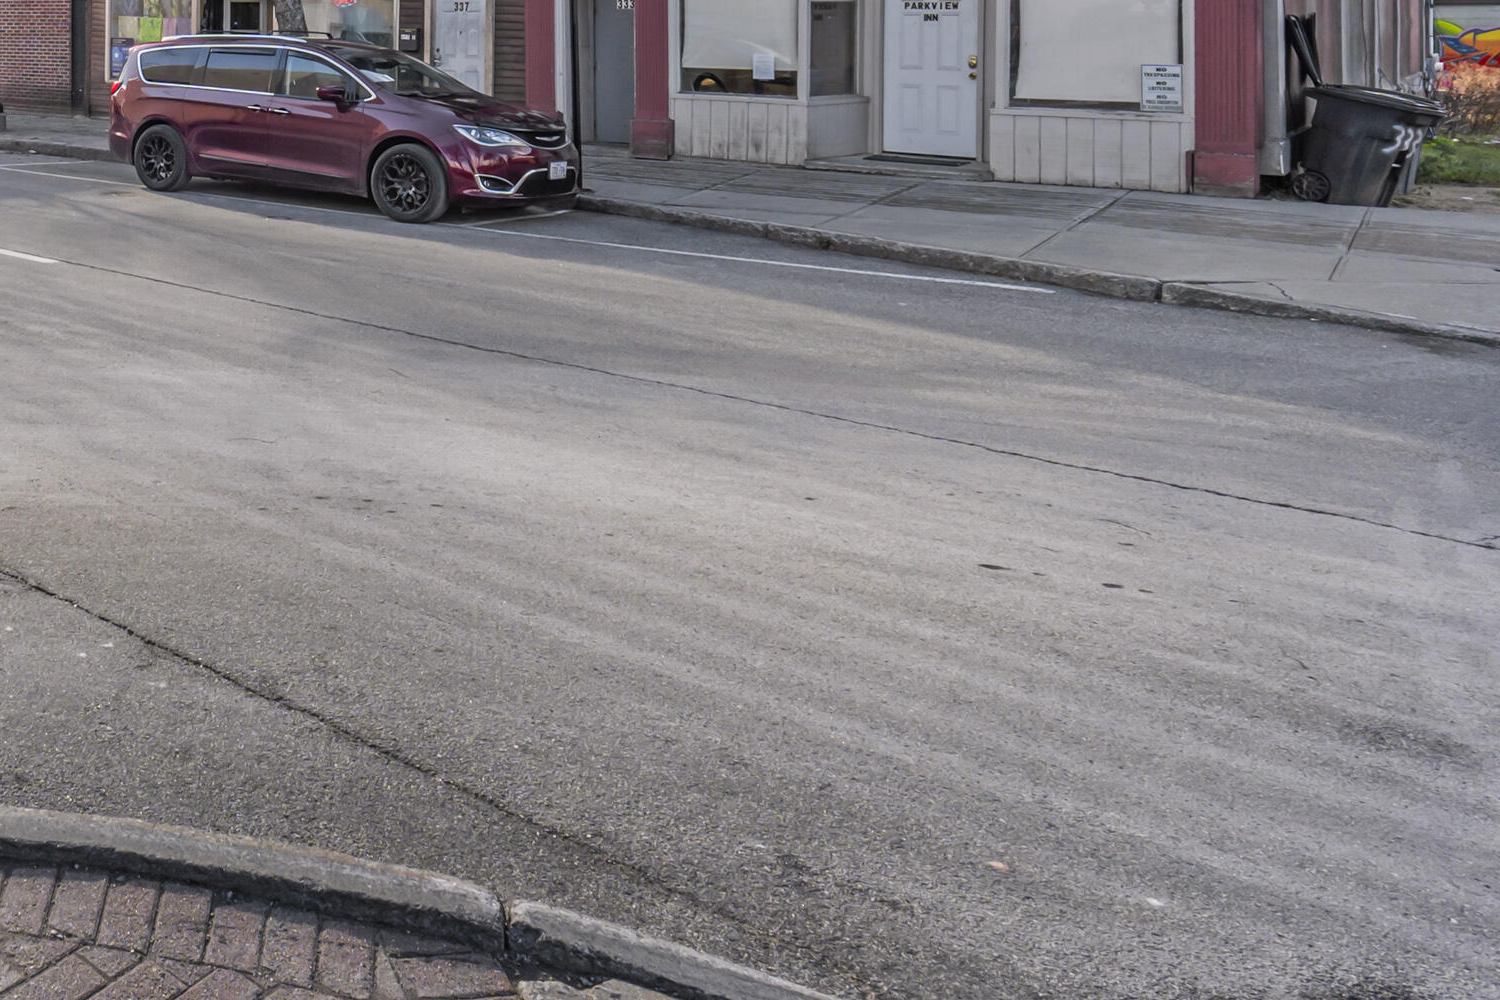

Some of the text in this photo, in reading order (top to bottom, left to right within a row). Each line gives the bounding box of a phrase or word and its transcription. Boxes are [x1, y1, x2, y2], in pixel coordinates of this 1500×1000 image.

[454, 2, 469, 12] 337
[904, 2, 959, 10] PARKVIEW
[923, 13, 939, 21] INN
